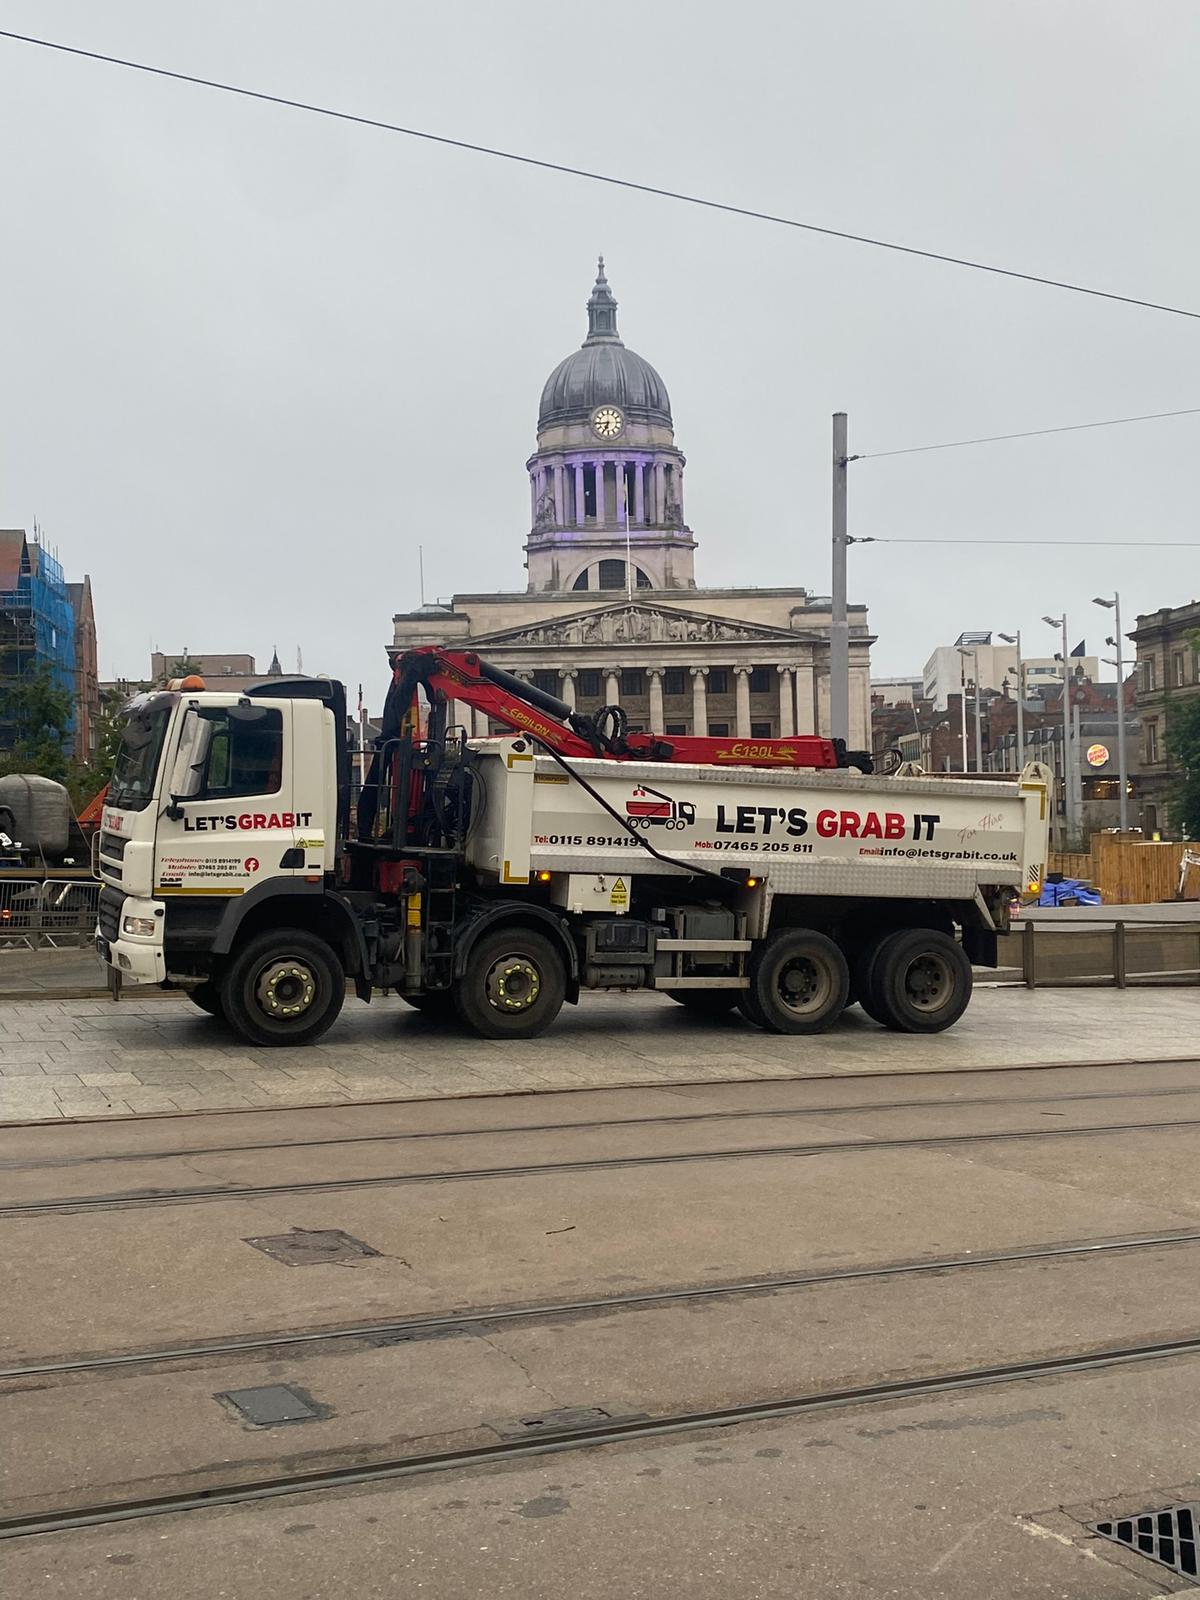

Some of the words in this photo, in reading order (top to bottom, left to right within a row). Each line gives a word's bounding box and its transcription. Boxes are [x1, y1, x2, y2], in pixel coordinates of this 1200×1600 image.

[510, 708, 551, 737] EPSILON
[732, 743, 774, 758] E120L
[715, 805, 809, 836] LET'S
[816, 809, 906, 839] GRAB
[912, 814, 941, 841] IT
[762, 842, 790, 852] 205
[792, 843, 813, 853] 811
